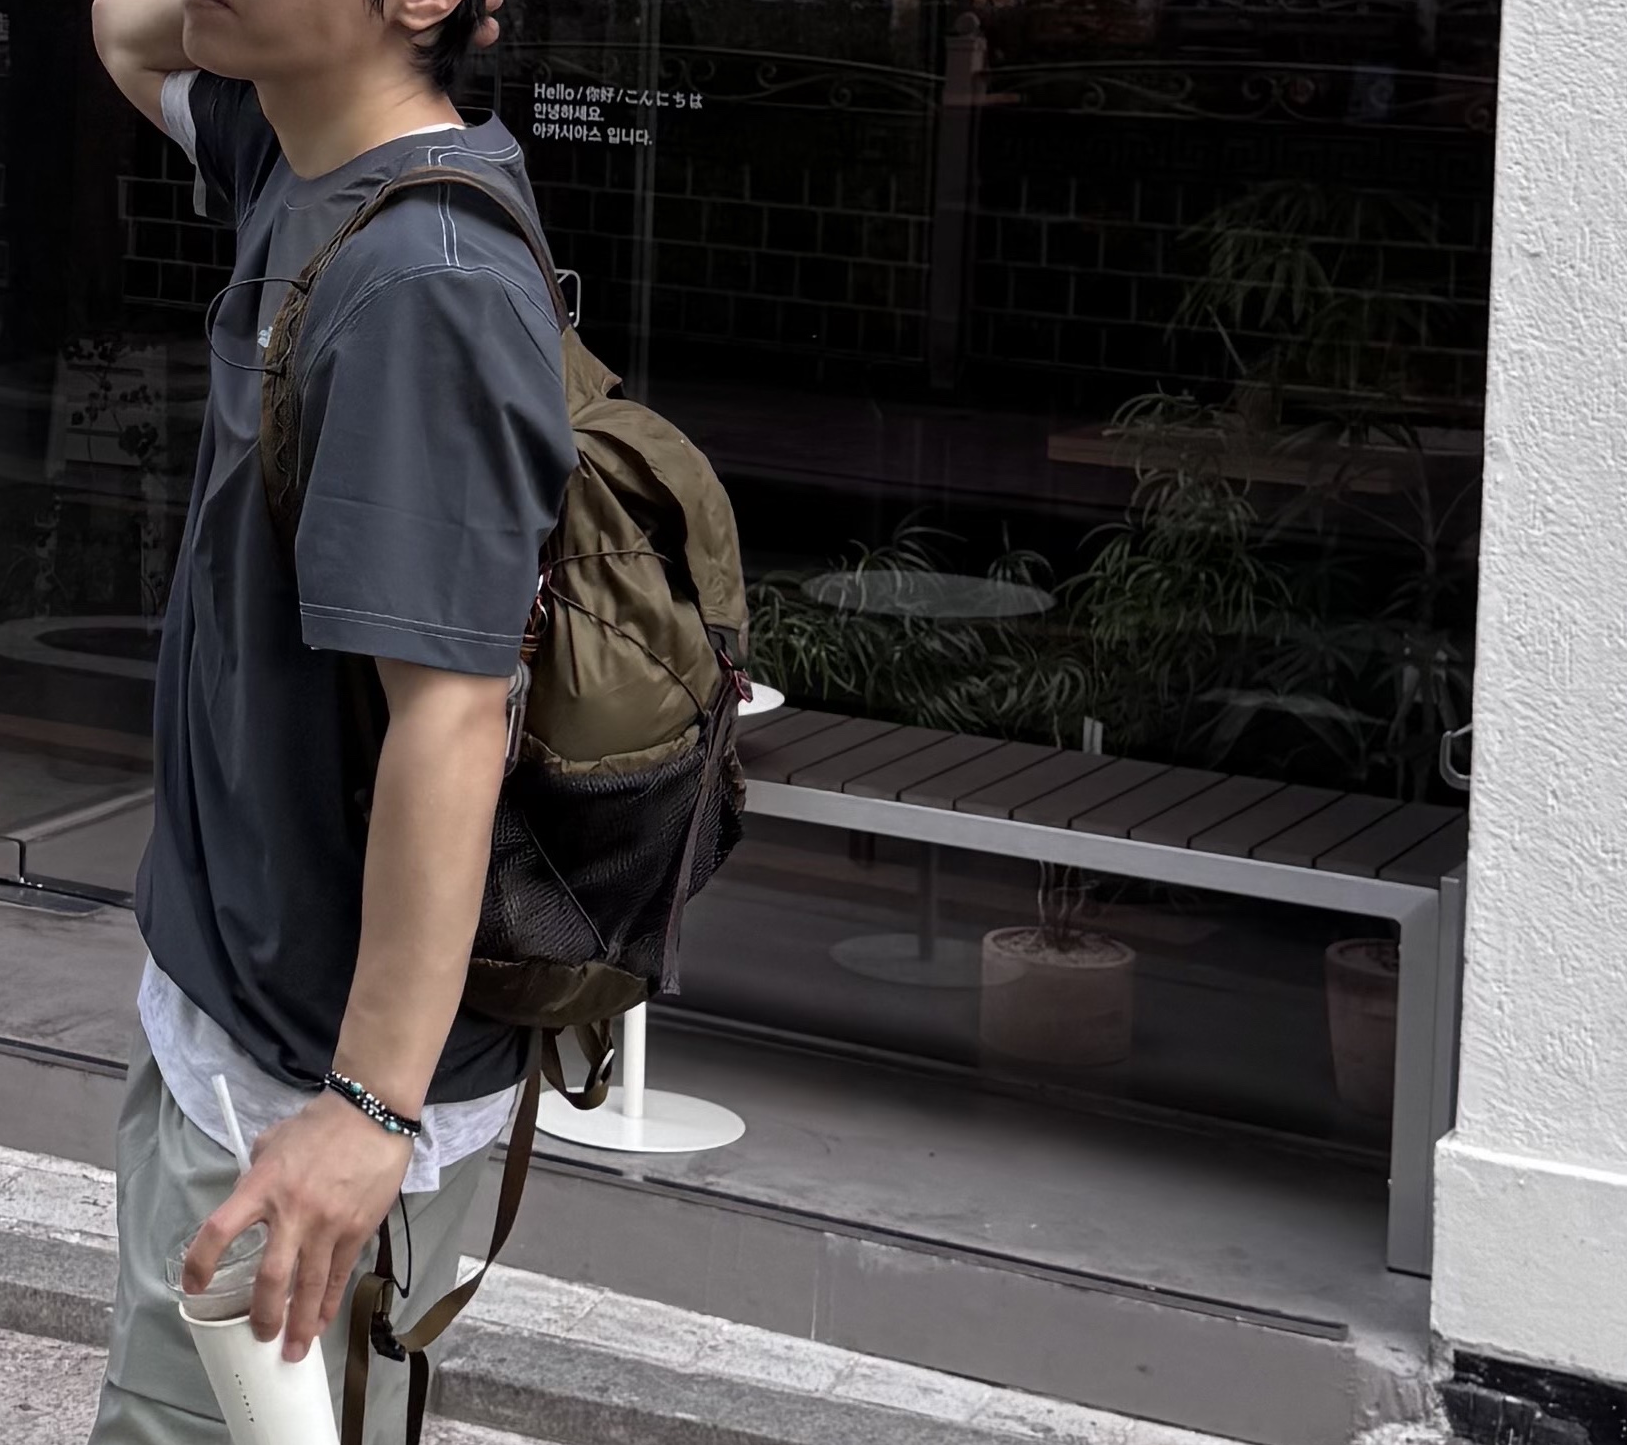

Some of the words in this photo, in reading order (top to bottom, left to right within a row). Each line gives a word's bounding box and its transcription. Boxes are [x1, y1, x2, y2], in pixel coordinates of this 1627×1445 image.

[534, 83, 575, 100] Hello
[586, 86, 614, 103] 你好
[625, 90, 703, 109] こんにちは
[534, 103, 604, 121] 안녕하세요.
[533, 122, 602, 141] 아카시아스
[607, 127, 652, 145] 입니다.
